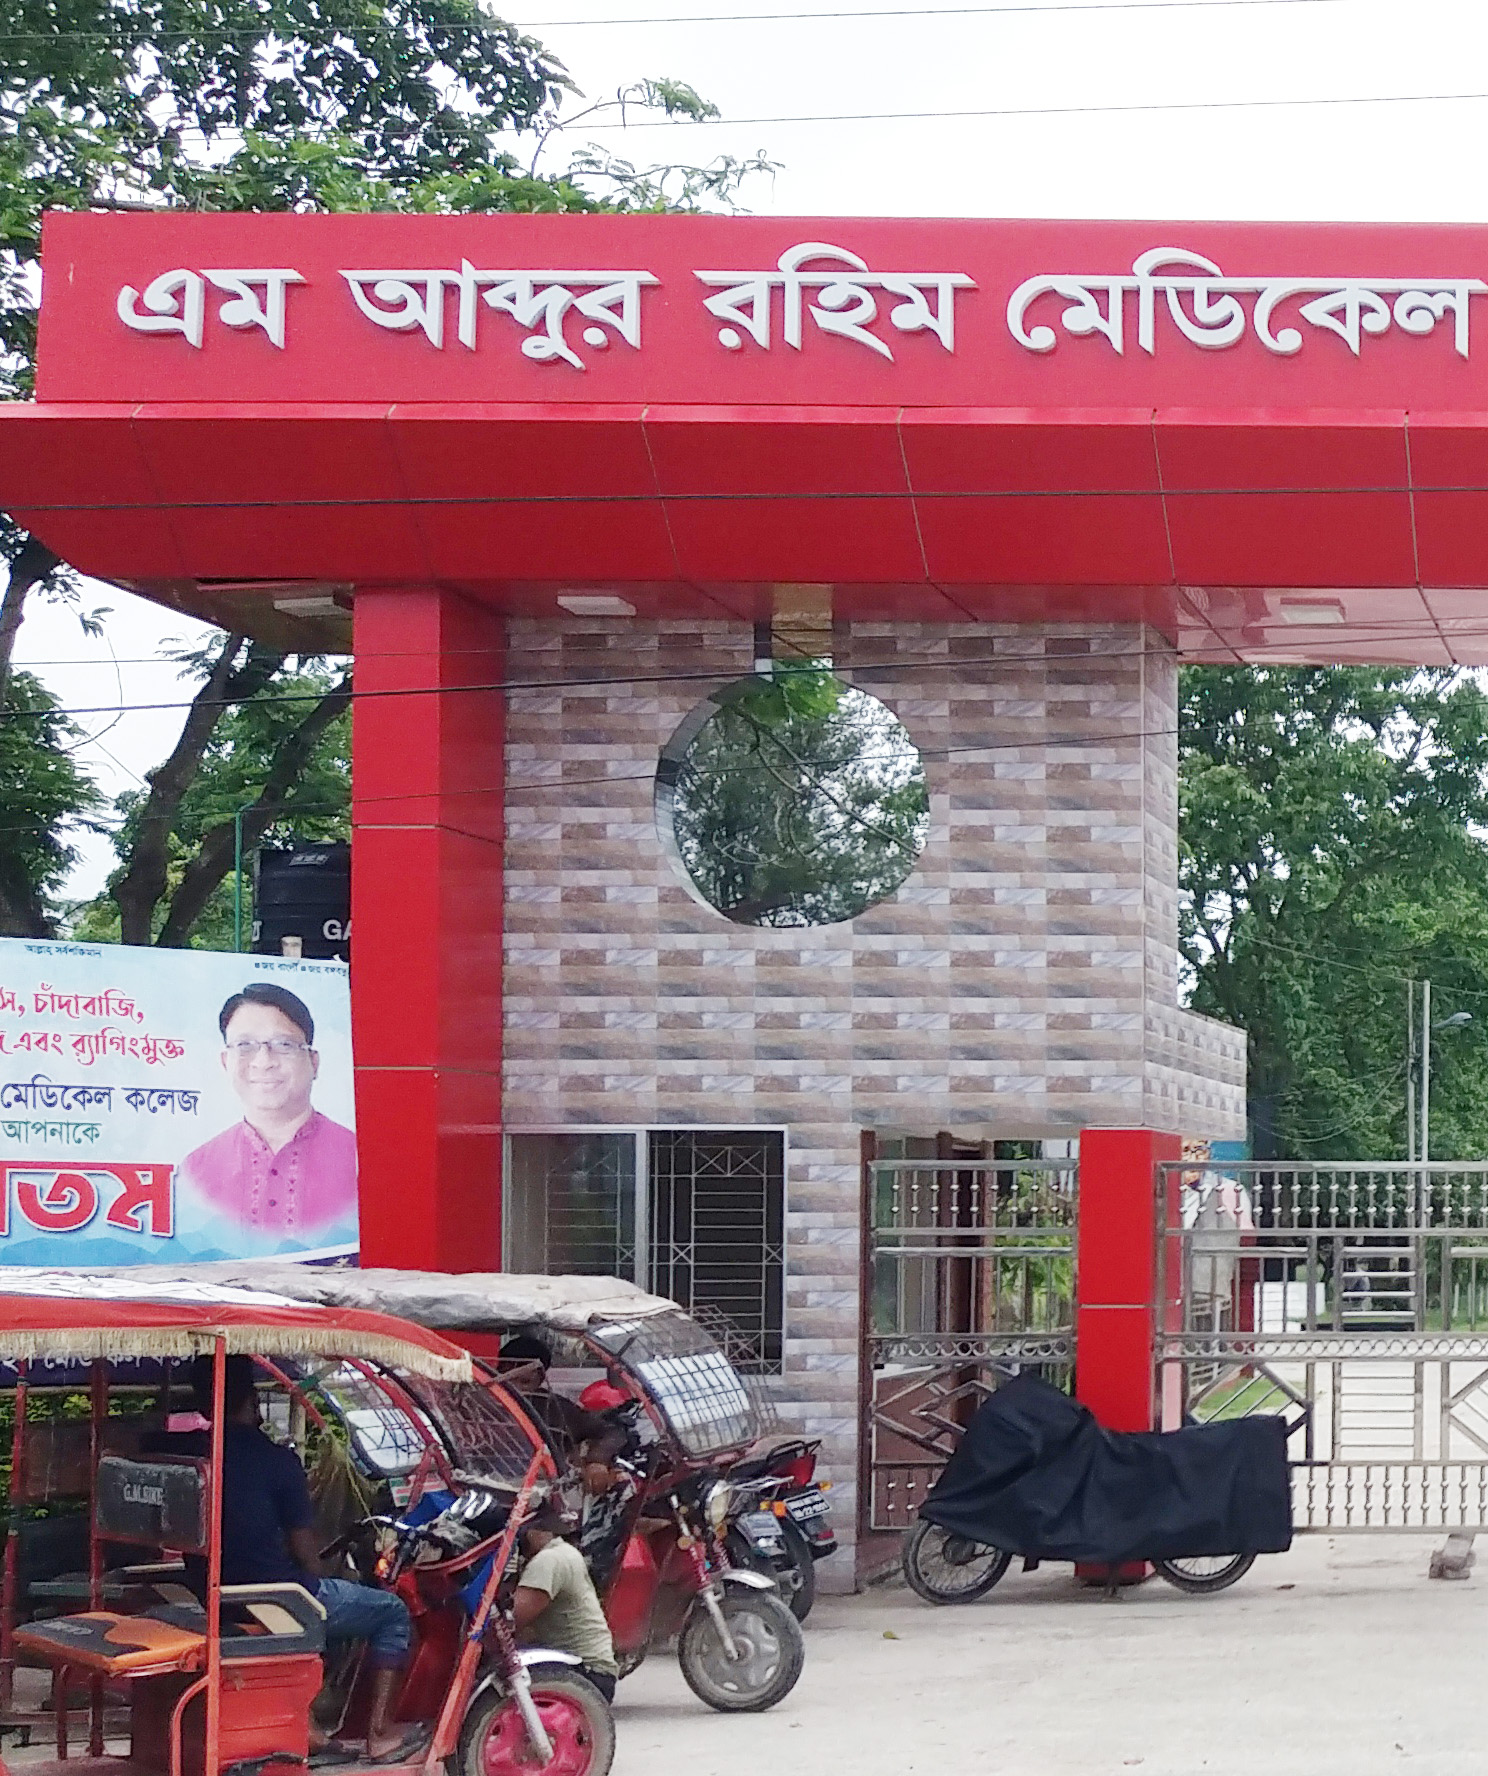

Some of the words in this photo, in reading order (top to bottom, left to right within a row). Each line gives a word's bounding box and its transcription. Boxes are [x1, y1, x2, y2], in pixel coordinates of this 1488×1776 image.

[116, 267, 306, 350] এম
[337, 257, 661, 370] আব্দুর
[691, 241, 978, 361] রহিম
[33, 982, 144, 1024] চাঁদাবাজি,
[13, 1032, 64, 1056] এবং
[0, 1073, 116, 1112] মেডিকেল
[121, 1087, 202, 1116] কলেজ
[0, 1119, 103, 1145] আপনাকে
[0, 1161, 176, 1237] তম
